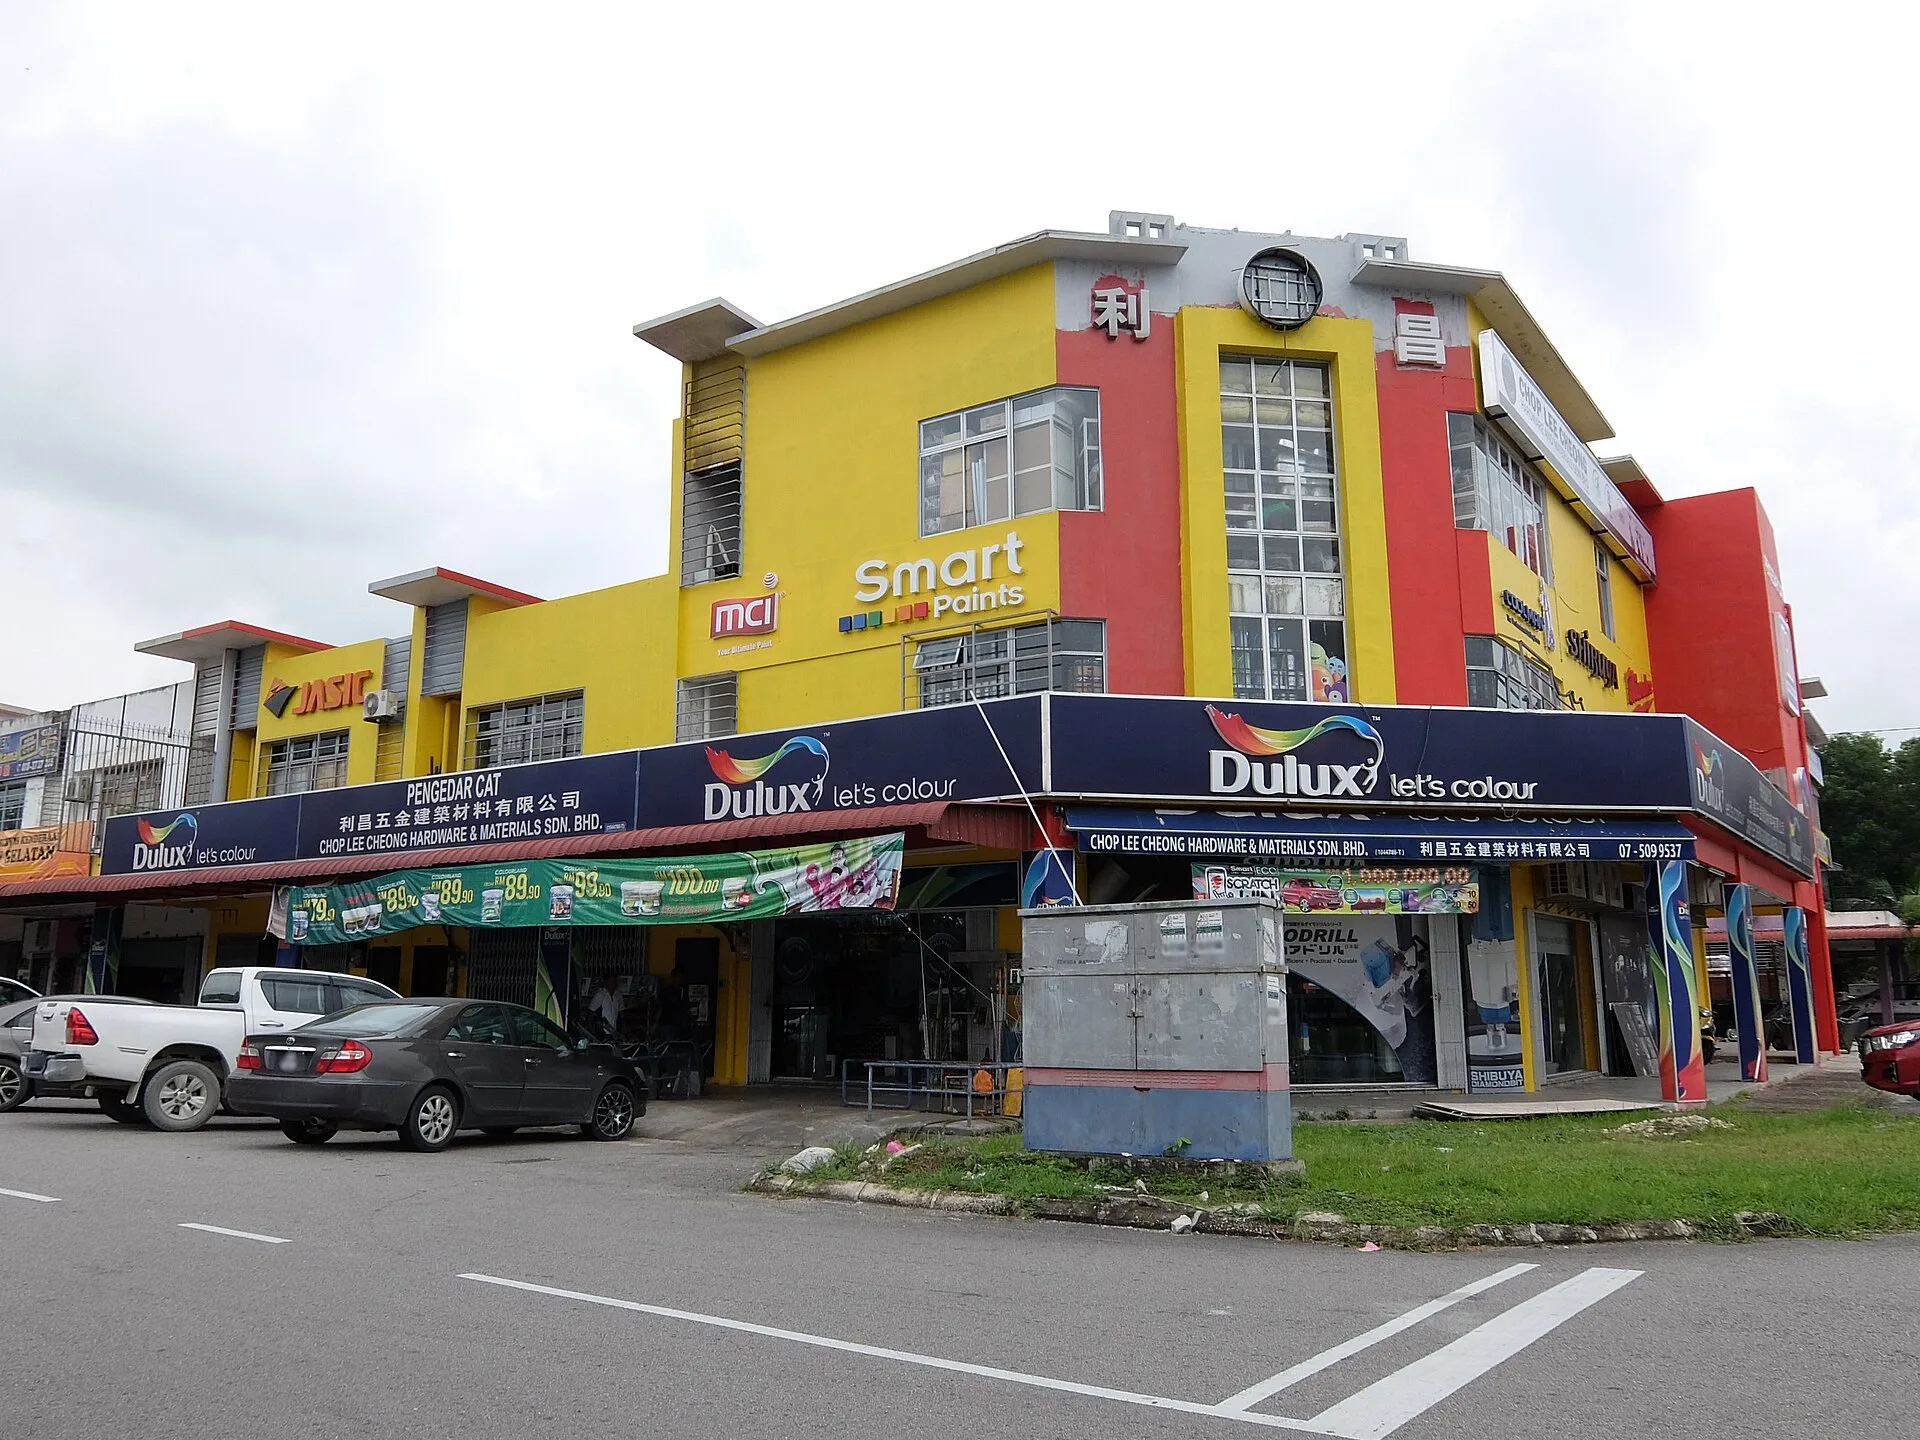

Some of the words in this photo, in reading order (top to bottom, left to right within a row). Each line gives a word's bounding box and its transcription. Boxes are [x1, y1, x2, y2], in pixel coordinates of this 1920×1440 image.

[1094, 287, 1150, 339] 利
[1395, 313, 1446, 365] 昌
[1519, 378, 1542, 416] CHOP
[1543, 409, 1559, 439] LEE
[1559, 433, 1589, 474] CHEONG
[854, 531, 1025, 602] Smart
[933, 583, 1026, 619] Paints
[292, 670, 373, 715] JASIC
[406, 777, 474, 806] PENGEDAR
[475, 773, 502, 799] CAT
[1208, 749, 1364, 797] Dulux
[1389, 773, 1447, 799] let's
[1450, 775, 1538, 801] colour
[1696, 767, 1723, 813] Dulux
[339, 790, 581, 833] 利昌五金建築材料有限公司
[704, 780, 812, 821] Dulux
[833, 782, 876, 808] let's
[882, 777, 957, 802] colour
[319, 838, 346, 854] CHOP
[346, 836, 366, 852] LEE
[366, 832, 408, 850] CHEONG
[409, 826, 467, 847] HARDWARE
[469, 825, 478, 841] &
[479, 818, 542, 840] MATERIALS
[543, 816, 572, 834] SDN.
[574, 813, 603, 832] BHD.
[1090, 833, 1120, 851] CHOP
[1121, 834, 1139, 851] LEE
[1141, 835, 1185, 853] CHEONG
[1187, 836, 1247, 854] HARDWARE
[1248, 838, 1257, 854] &
[1258, 838, 1315, 855] MATERIALS
[1316, 839, 1342, 856] SDN.
[1343, 840, 1368, 857] BHD.
[1419, 841, 1591, 858] 利昌五金建築材料有限公司
[132, 842, 187, 870] Dulux
[196, 847, 218, 864] let's
[219, 845, 257, 862] colour
[1226, 878, 1279, 890] SCRATCH
[1284, 928, 1359, 943] ODRILL
[1470, 1069, 1523, 1082] SHIBUYA
[1471, 1079, 1523, 1088] DIAMONDBIT
